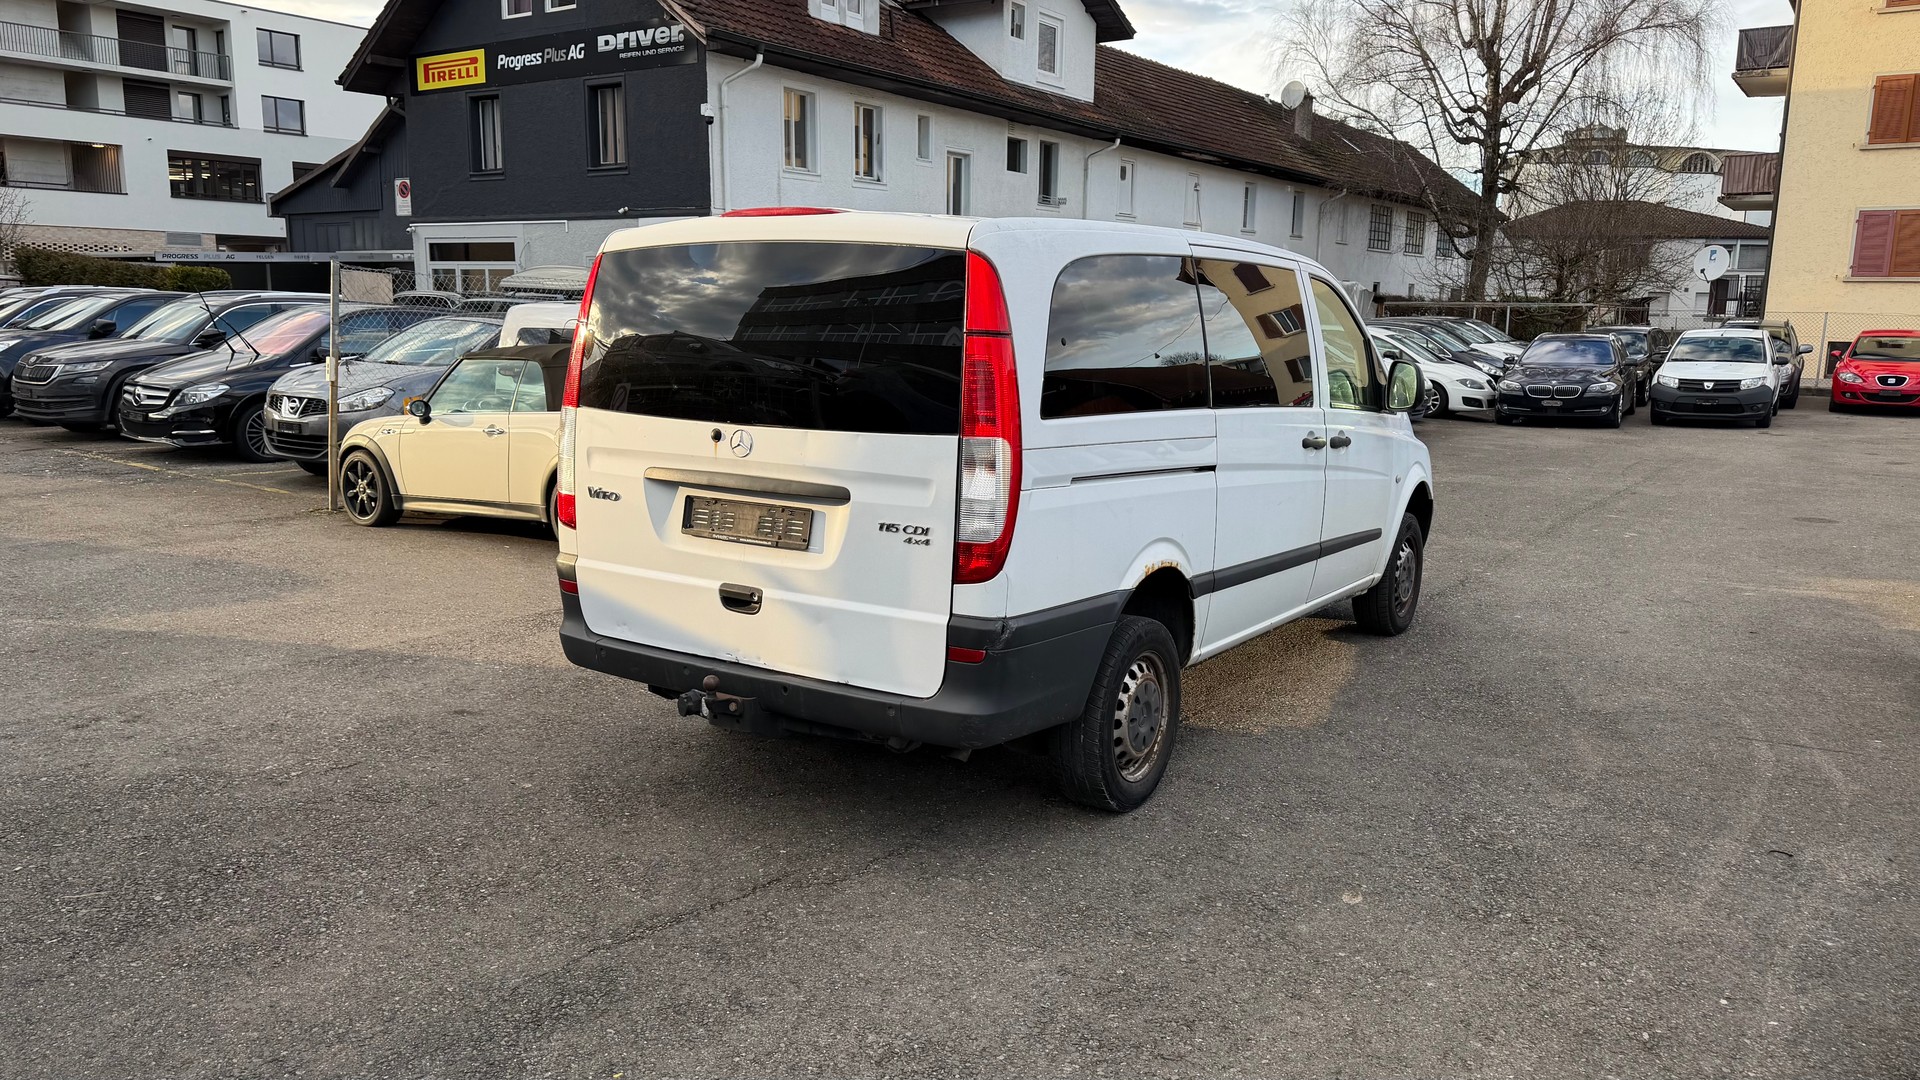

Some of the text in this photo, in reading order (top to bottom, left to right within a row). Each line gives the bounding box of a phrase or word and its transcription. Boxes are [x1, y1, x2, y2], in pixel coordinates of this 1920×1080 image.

[497, 43, 585, 70] Progress Plus AG
[619, 45, 685, 59] REIFEN UND SERVICE
[423, 57, 478, 83] PIRELLI
[878, 522, 931, 537] 115 CDI
[903, 537, 931, 547] 4x4
